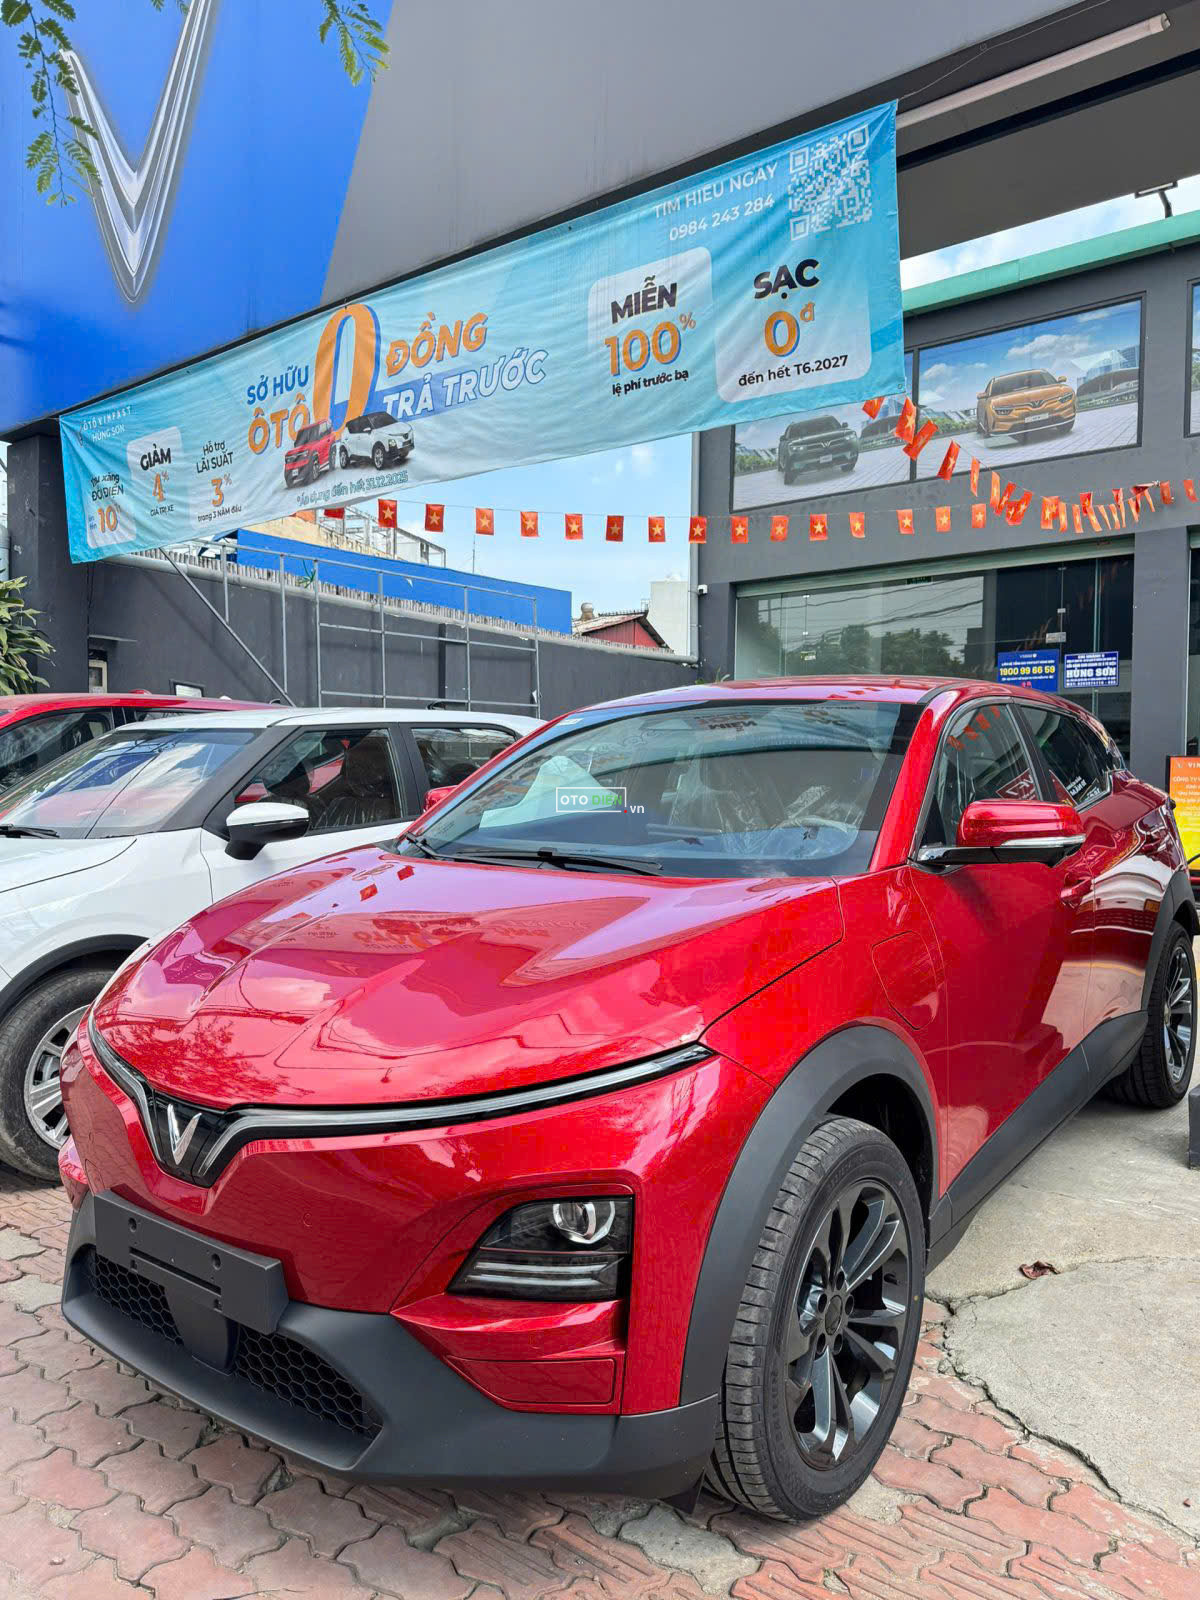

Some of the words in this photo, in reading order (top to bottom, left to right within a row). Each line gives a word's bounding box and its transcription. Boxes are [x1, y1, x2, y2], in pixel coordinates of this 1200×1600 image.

[729, 161, 779, 193] NGAY
[669, 217, 708, 241] 0984
[711, 205, 740, 228] 243
[743, 192, 776, 217] 284
[609, 274, 678, 324] MIỄN
[753, 258, 820, 300] SẠC
[385, 311, 489, 377] ĐỒNG
[604, 311, 697, 377] 100%
[246, 374, 269, 406] SỞ
[272, 364, 309, 397] HỮU
[383, 372, 435, 420] TRẢ
[442, 347, 549, 407] TRƯỚC
[611, 382, 622, 397] lệ
[623, 377, 641, 395] phí
[642, 372, 673, 388] trước
[674, 369, 689, 382] bạ
[738, 371, 764, 387] đến
[767, 364, 791, 381] hết
[793, 354, 849, 376] T6.2027
[247, 390, 312, 456] ÔTÔ
[140, 443, 172, 471] GIẢM
[196, 457, 210, 474] LÃI
[1000, 667, 1019, 676] 1900
